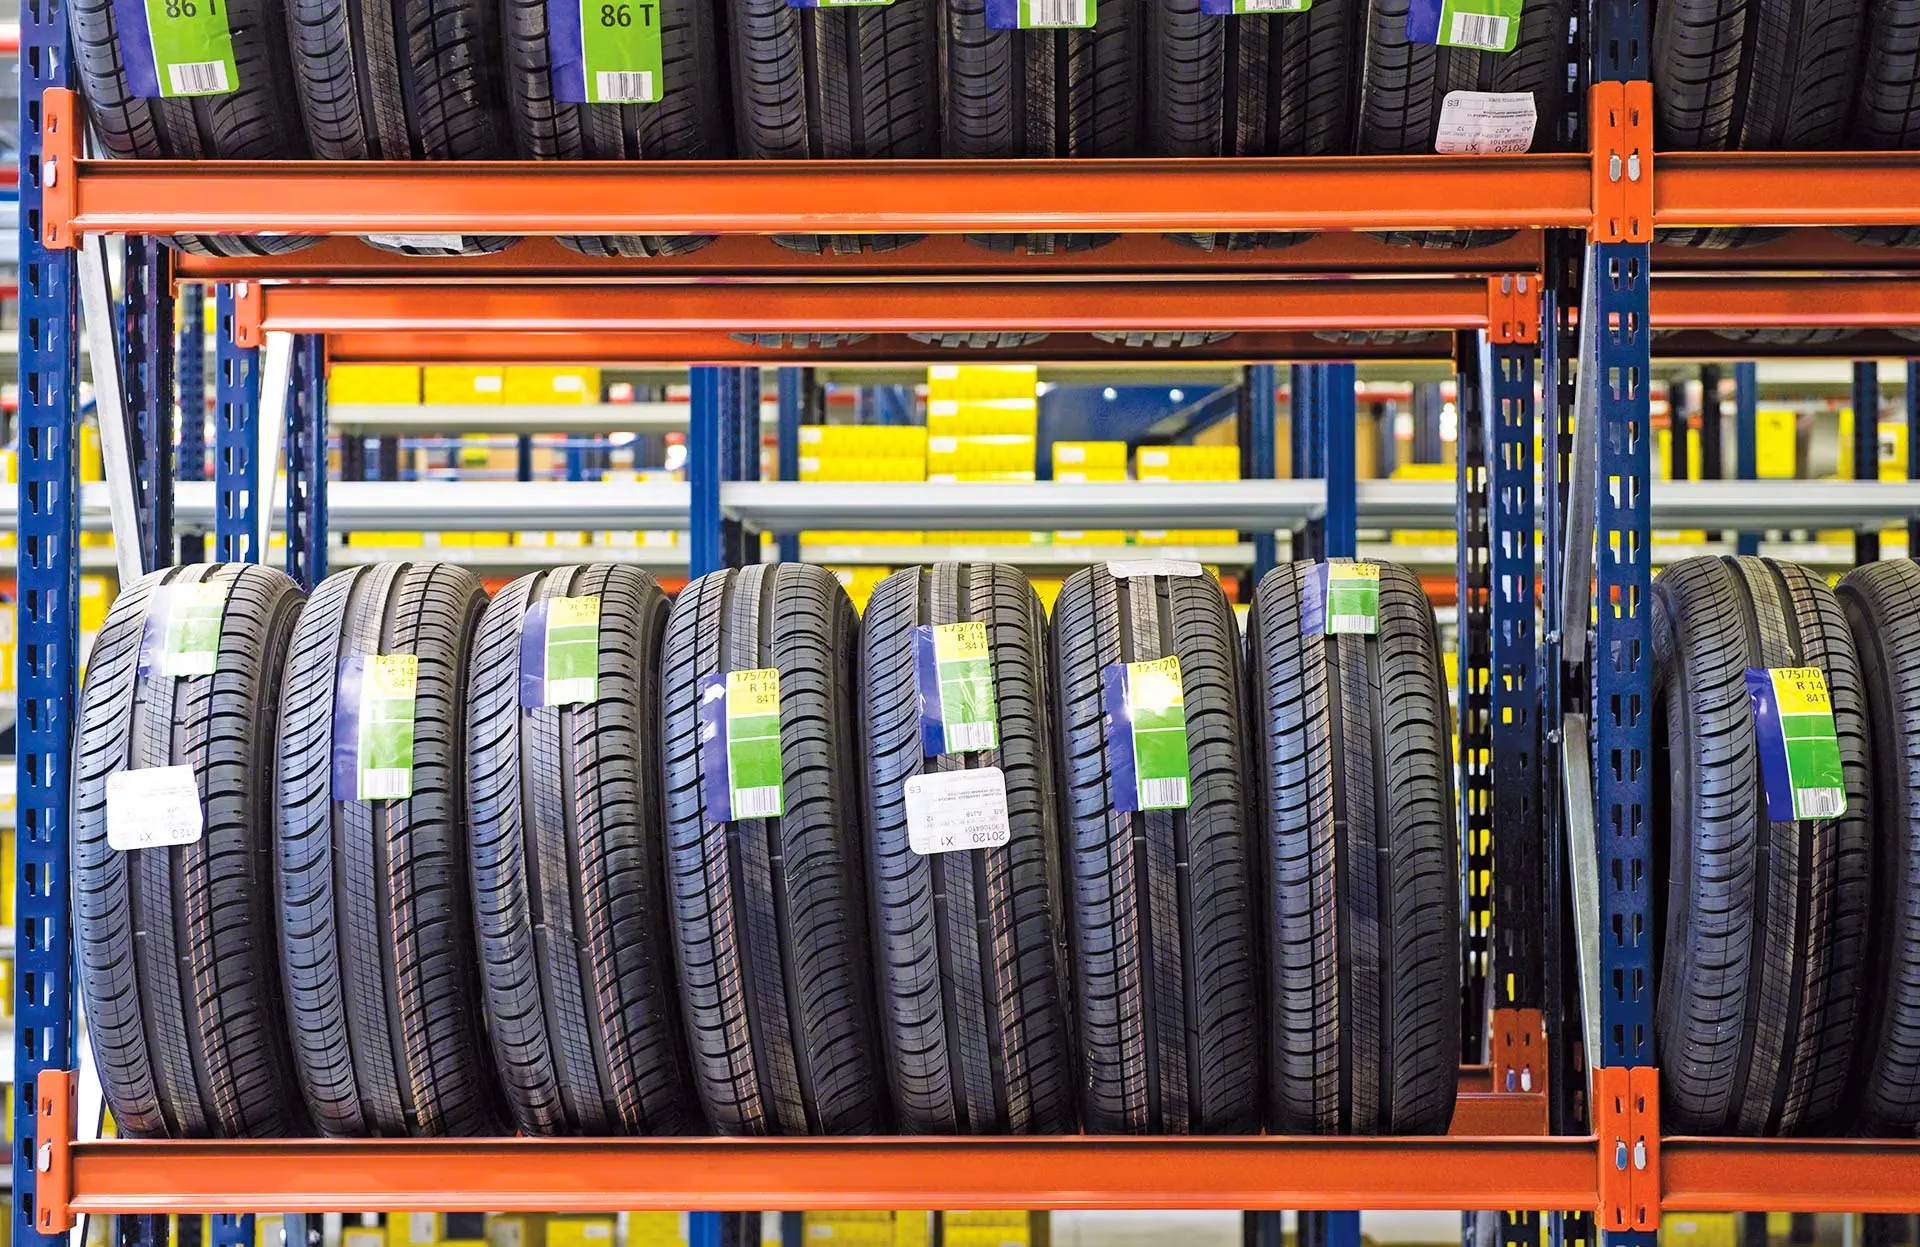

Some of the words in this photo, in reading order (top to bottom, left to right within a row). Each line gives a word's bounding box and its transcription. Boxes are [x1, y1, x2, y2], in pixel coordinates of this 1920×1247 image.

[166, 0, 196, 18] 86
[600, 4, 632, 27] 86
[639, 4, 654, 26] T
[1464, 144, 1478, 152] X1
[1494, 143, 1526, 153] 20120
[958, 634, 965, 642] R
[736, 670, 776, 682] 175/70
[1778, 669, 1820, 680] 175/70
[749, 684, 757, 693] R
[763, 682, 776, 692] 14
[1796, 682, 1805, 690] R
[1809, 681, 1824, 690] 14
[756, 694, 768, 704] 84
[770, 694, 776, 704] T
[1806, 694, 1819, 702] 84
[1820, 694, 1826, 702] T
[140, 832, 152, 842] X1
[940, 836, 954, 846] X1
[972, 831, 1006, 842] 20120
